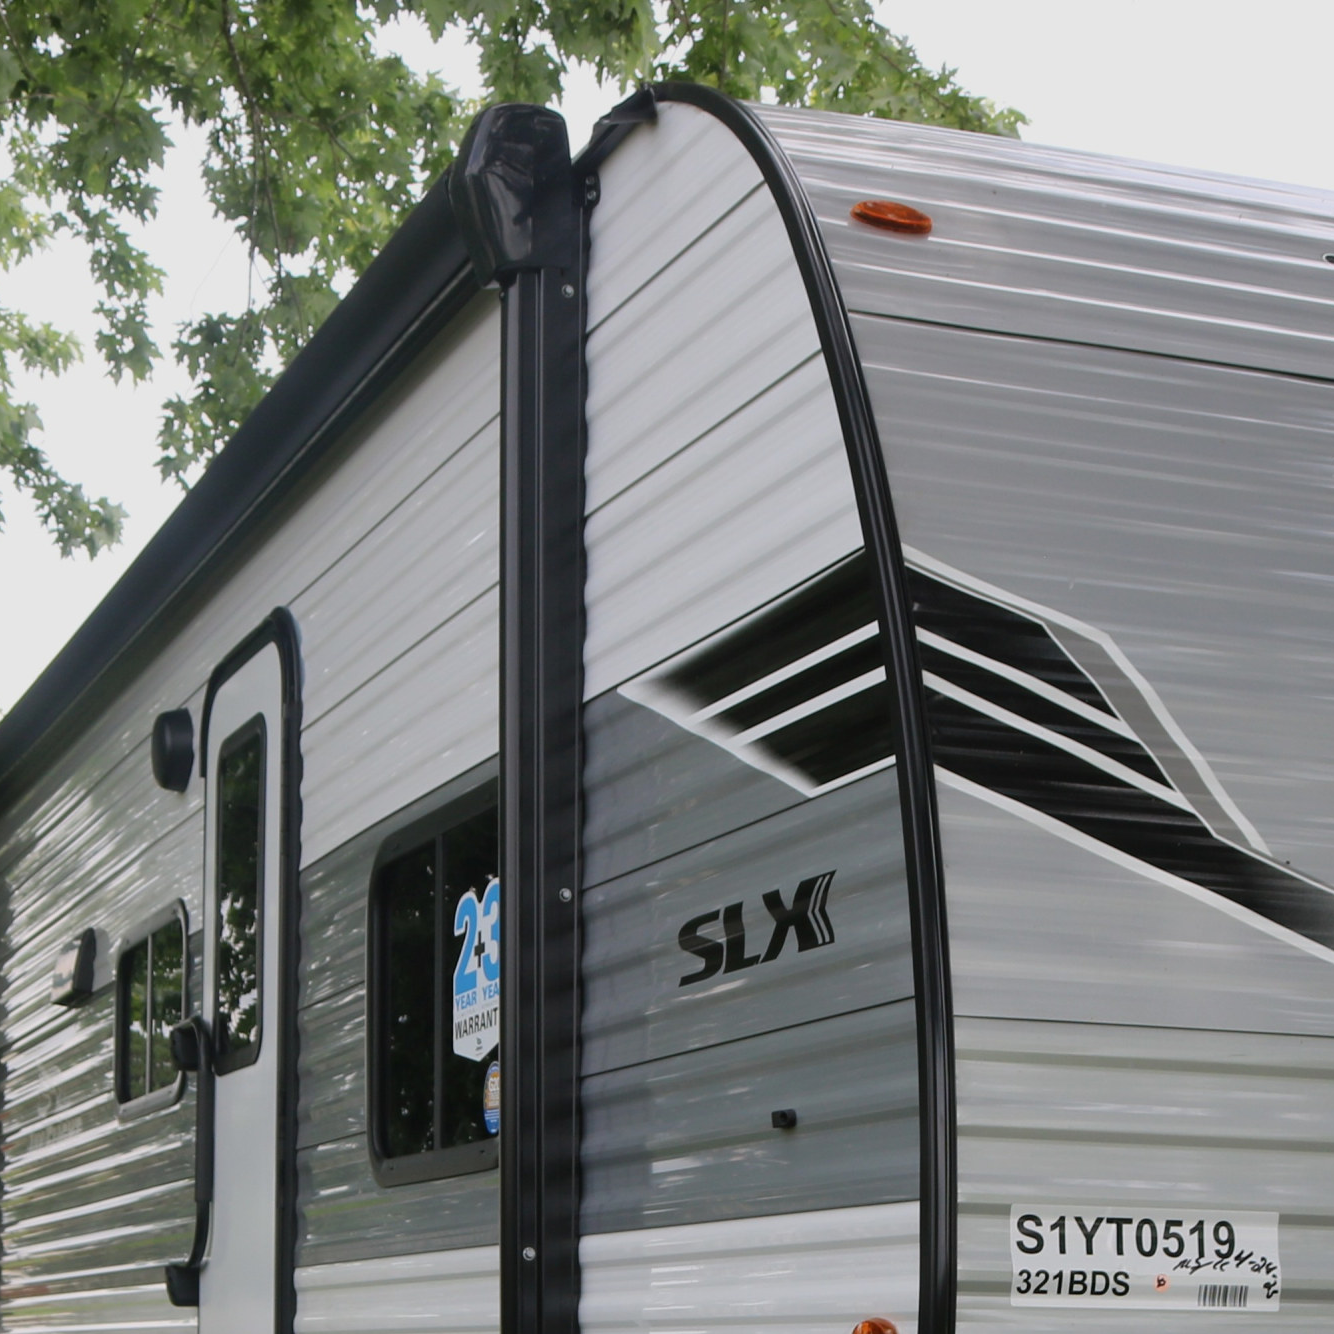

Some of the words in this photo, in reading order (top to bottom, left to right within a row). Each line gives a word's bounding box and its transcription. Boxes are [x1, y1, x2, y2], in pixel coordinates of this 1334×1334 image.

[678, 868, 838, 988] SLX
[455, 991, 478, 1012] YEAR
[482, 980, 499, 1000] YEA
[454, 1006, 499, 1041] WARRANT
[1015, 1213, 1235, 1260] S1YT0519
[1015, 1268, 1131, 1297] 321BDS
